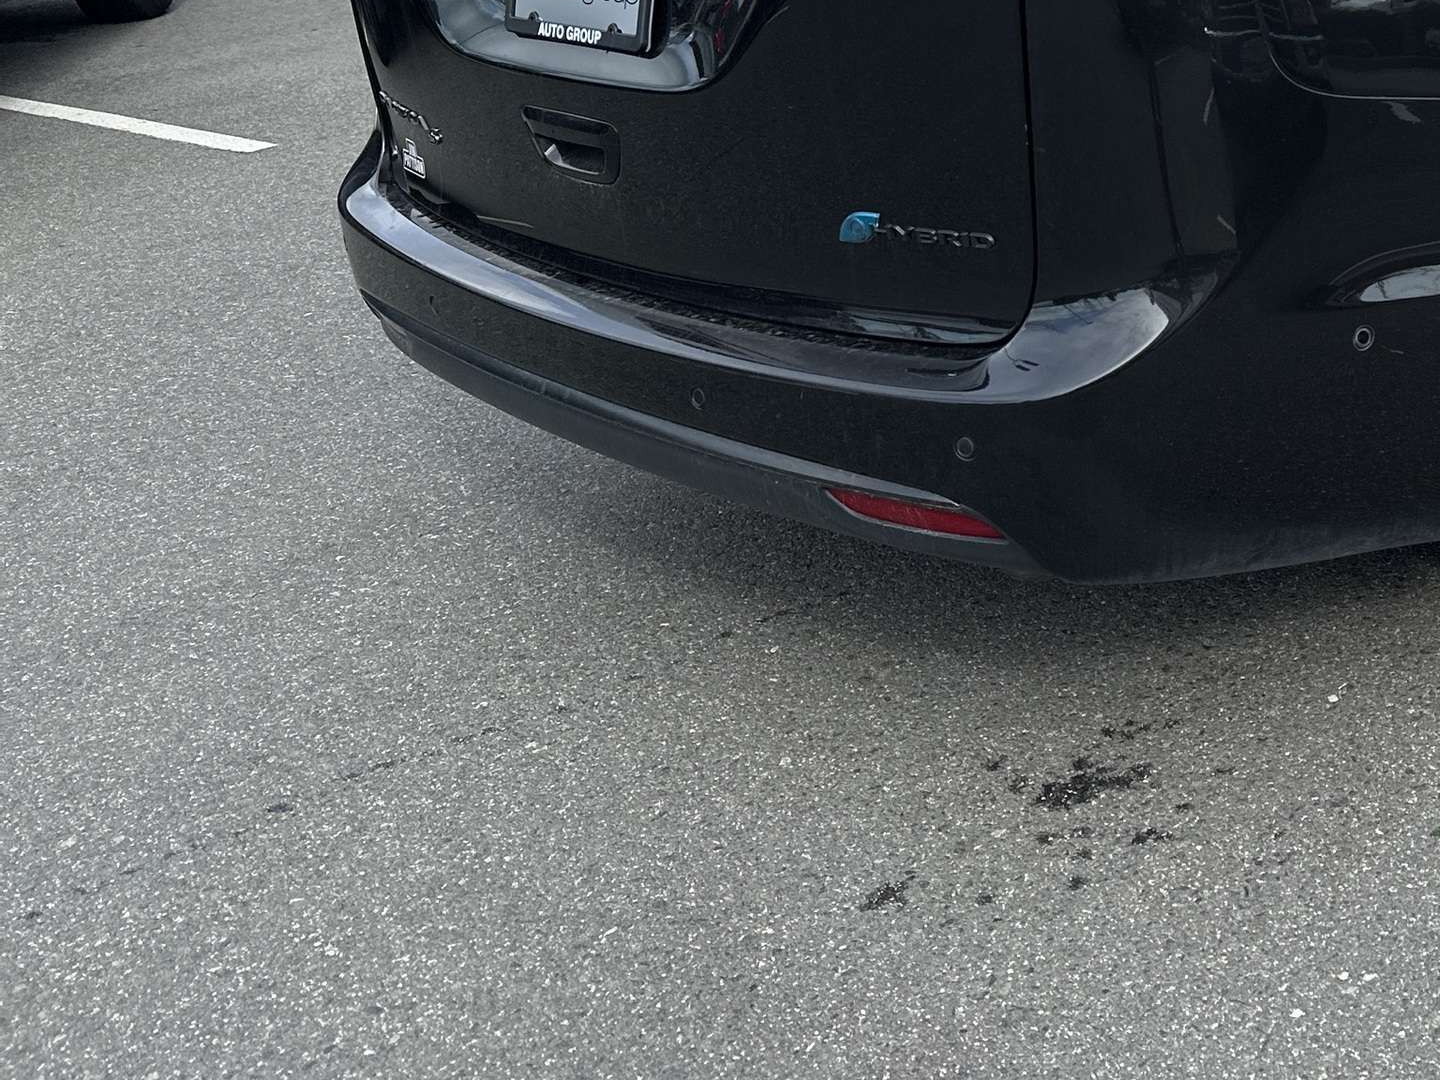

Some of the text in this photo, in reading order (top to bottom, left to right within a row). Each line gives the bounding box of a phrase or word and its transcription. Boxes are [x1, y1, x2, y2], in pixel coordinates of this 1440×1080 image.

[538, 22, 602, 45] AUTO GROUP
[874, 224, 995, 248] HYBRID
